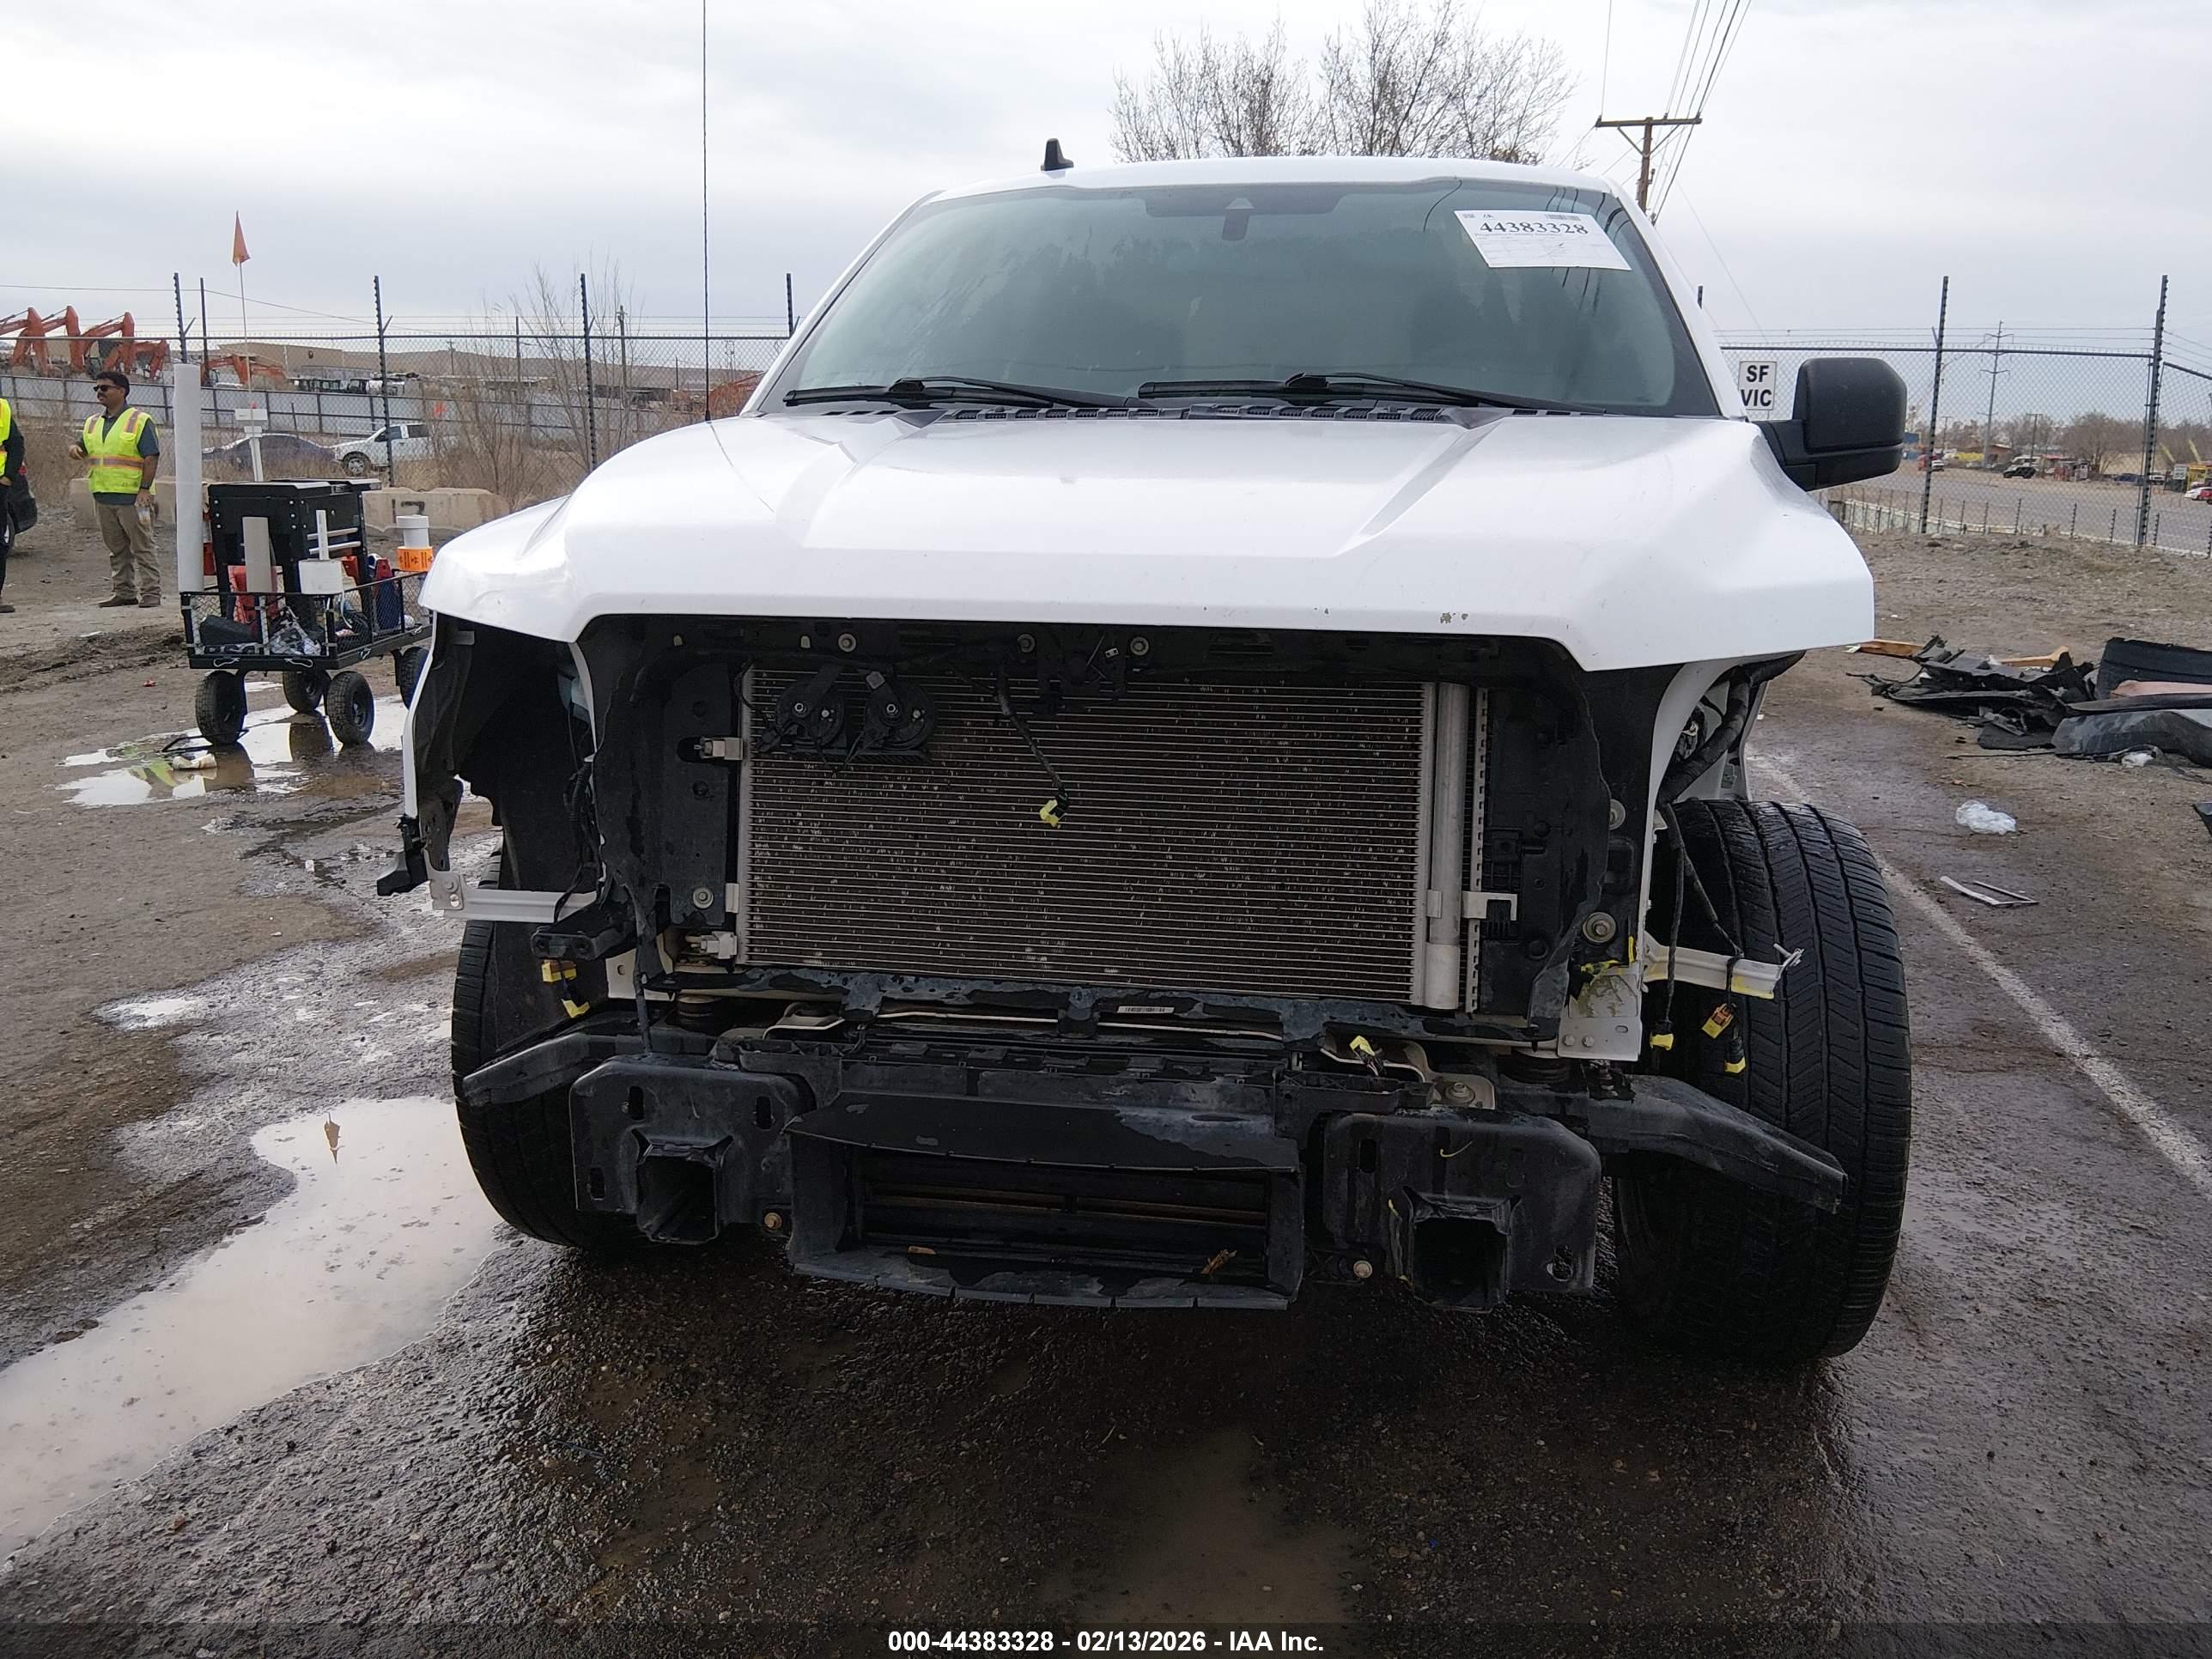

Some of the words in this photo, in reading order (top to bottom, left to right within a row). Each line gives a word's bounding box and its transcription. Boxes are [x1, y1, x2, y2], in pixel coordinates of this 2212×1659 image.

[1480, 222, 1589, 234] 44383328
[1746, 365, 1770, 383] SF
[1741, 389, 1772, 407] VIC
